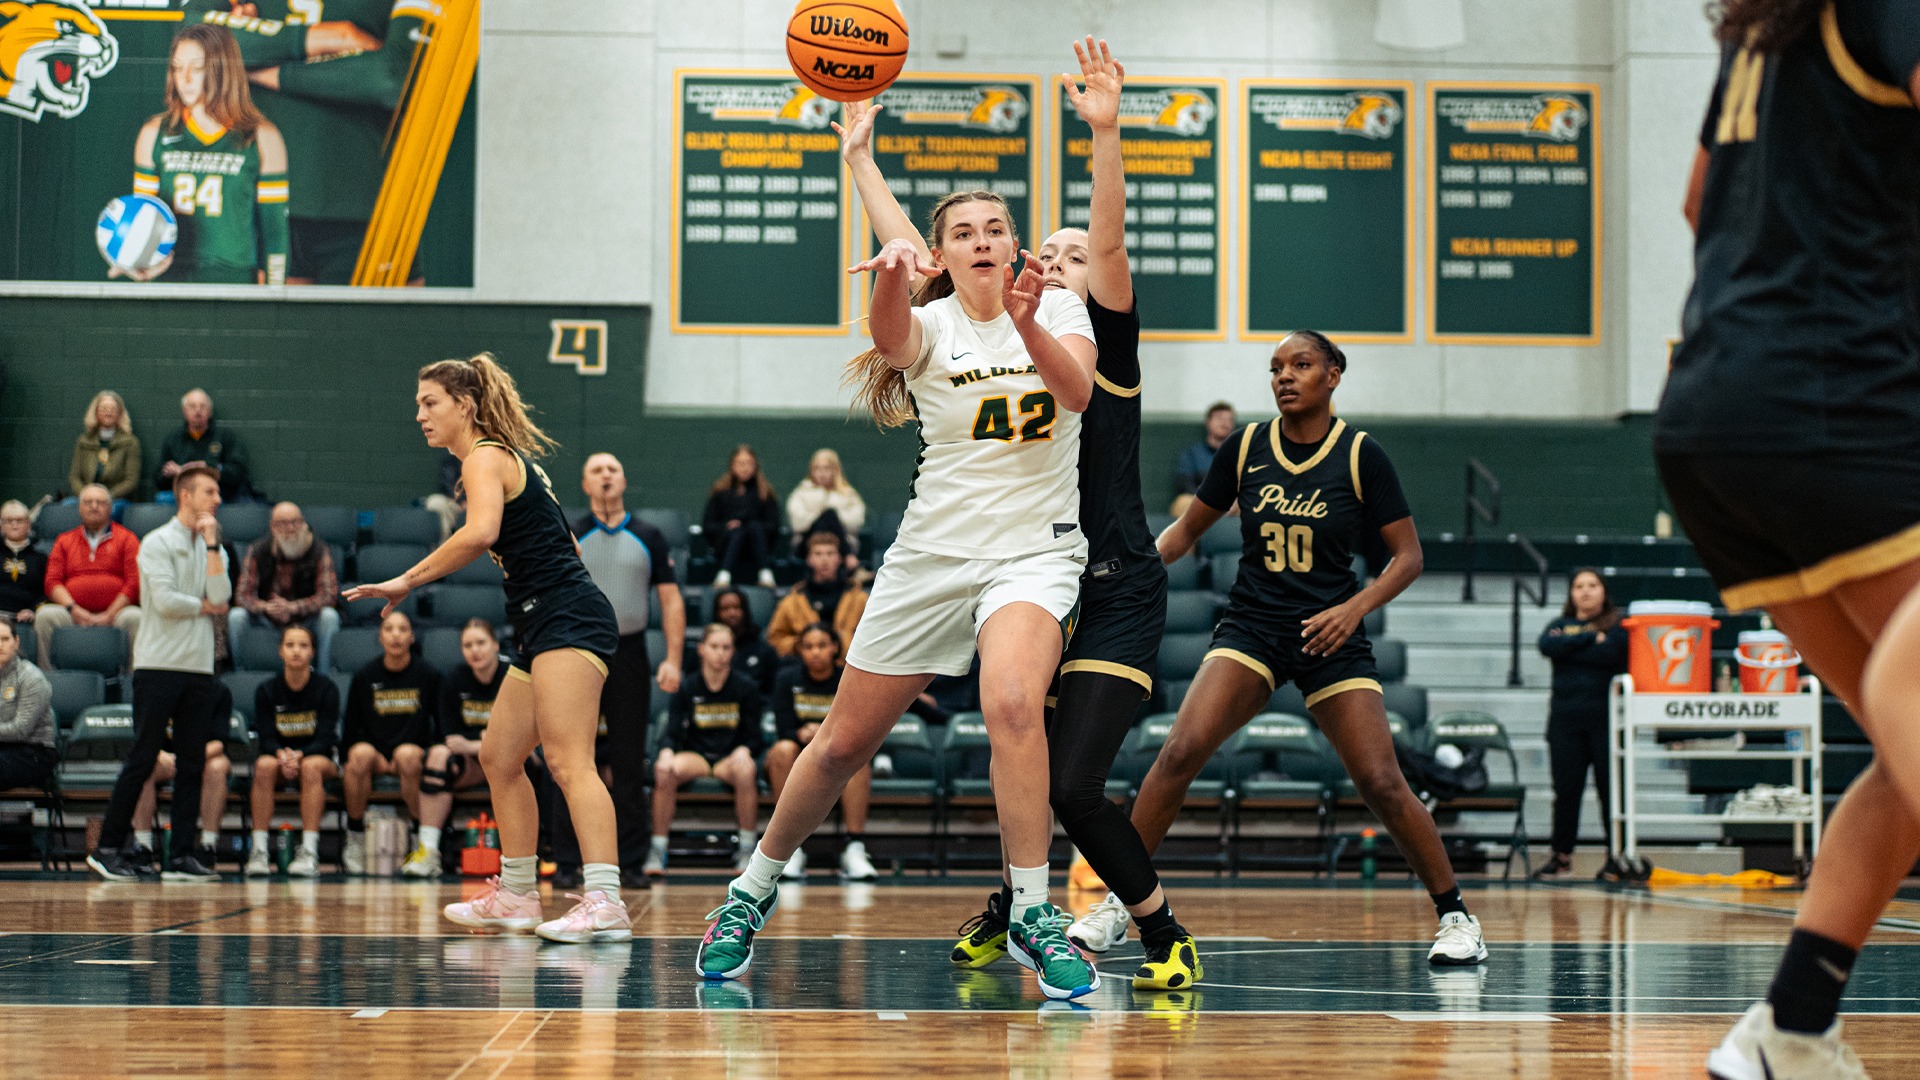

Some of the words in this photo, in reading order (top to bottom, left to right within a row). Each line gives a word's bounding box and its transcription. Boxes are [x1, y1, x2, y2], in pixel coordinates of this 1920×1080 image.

[811, 15, 889, 47] Wilson
[812, 56, 875, 81] NCAA
[726, 132, 786, 150] REGULAR
[788, 133, 839, 151] SEASON
[925, 136, 1026, 155] TOURNAMENT
[721, 151, 803, 169] CHAMPIONS
[1260, 150, 1300, 168] NCAA
[1303, 150, 1344, 169] ELITE
[1347, 151, 1392, 170] EIGHT
[1450, 143, 1490, 161] NCAA
[1492, 144, 1534, 162] FINAL
[1537, 144, 1578, 162] FOUR
[904, 155, 998, 173] CHAMPIONS
[173, 173, 223, 217] 24
[1479, 190, 1513, 208] 1997
[762, 201, 798, 219] 1997
[1451, 237, 1491, 256] NCAA
[1493, 238, 1553, 257] RUNNER
[1555, 239, 1578, 258] UP
[549, 319, 607, 374] 4
[949, 364, 1038, 388] WILDCA
[971, 389, 1057, 444] 42
[1253, 484, 1328, 518] Pride
[1260, 522, 1313, 573] 30
[1663, 630, 1690, 660] G
[1665, 700, 1780, 719] GATORADE
